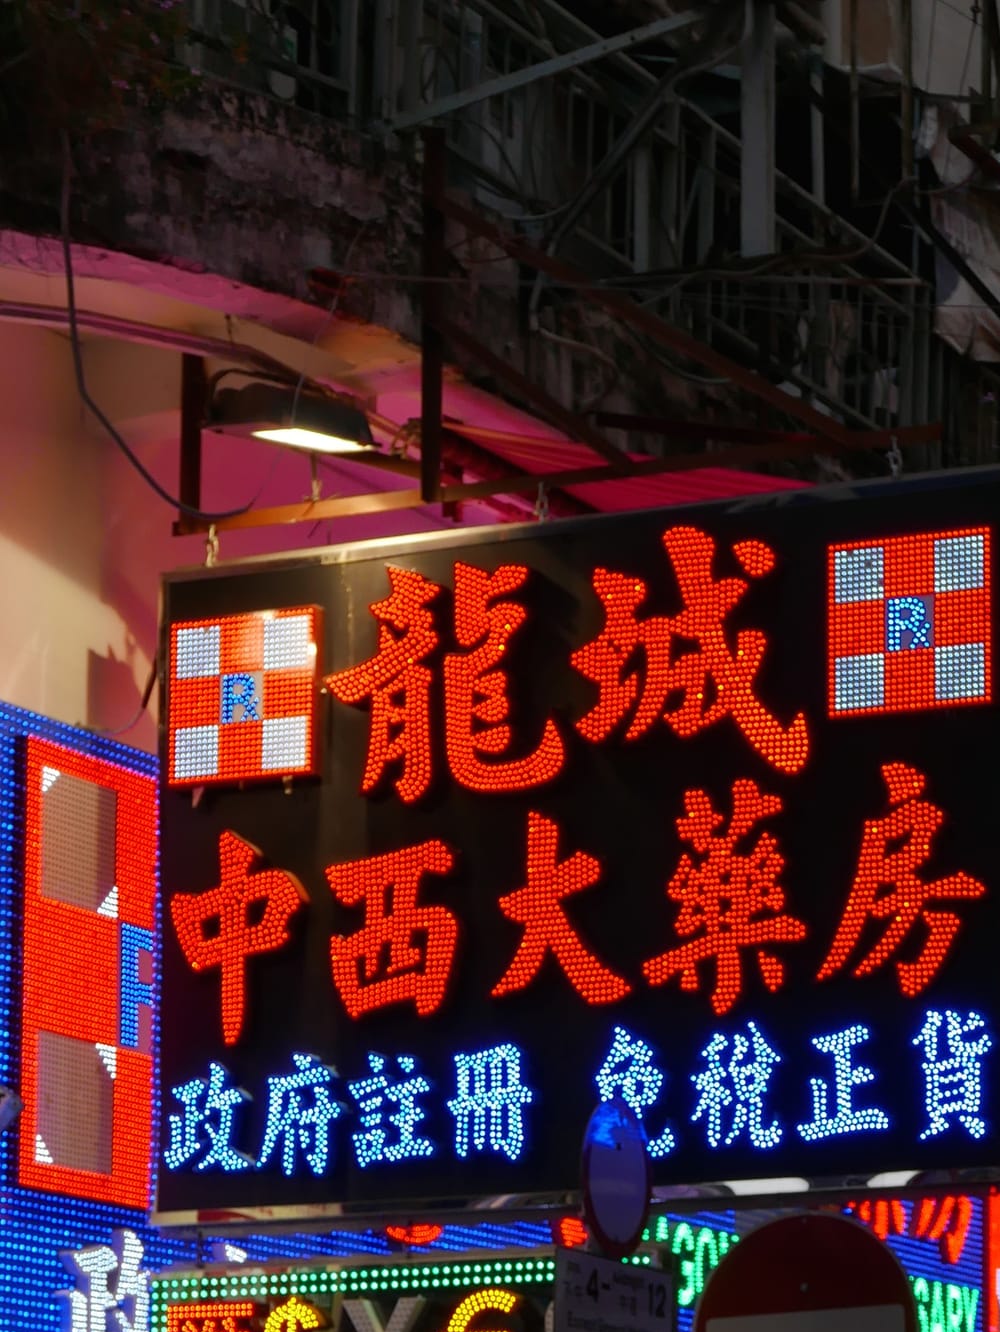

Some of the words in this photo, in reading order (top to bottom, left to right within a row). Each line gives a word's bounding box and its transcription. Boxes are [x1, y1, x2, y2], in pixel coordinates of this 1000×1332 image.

[325, 526, 810, 803] 龍城
[170, 763, 985, 1046] 中西大藥房
[164, 1043, 532, 1176] 政府註冊
